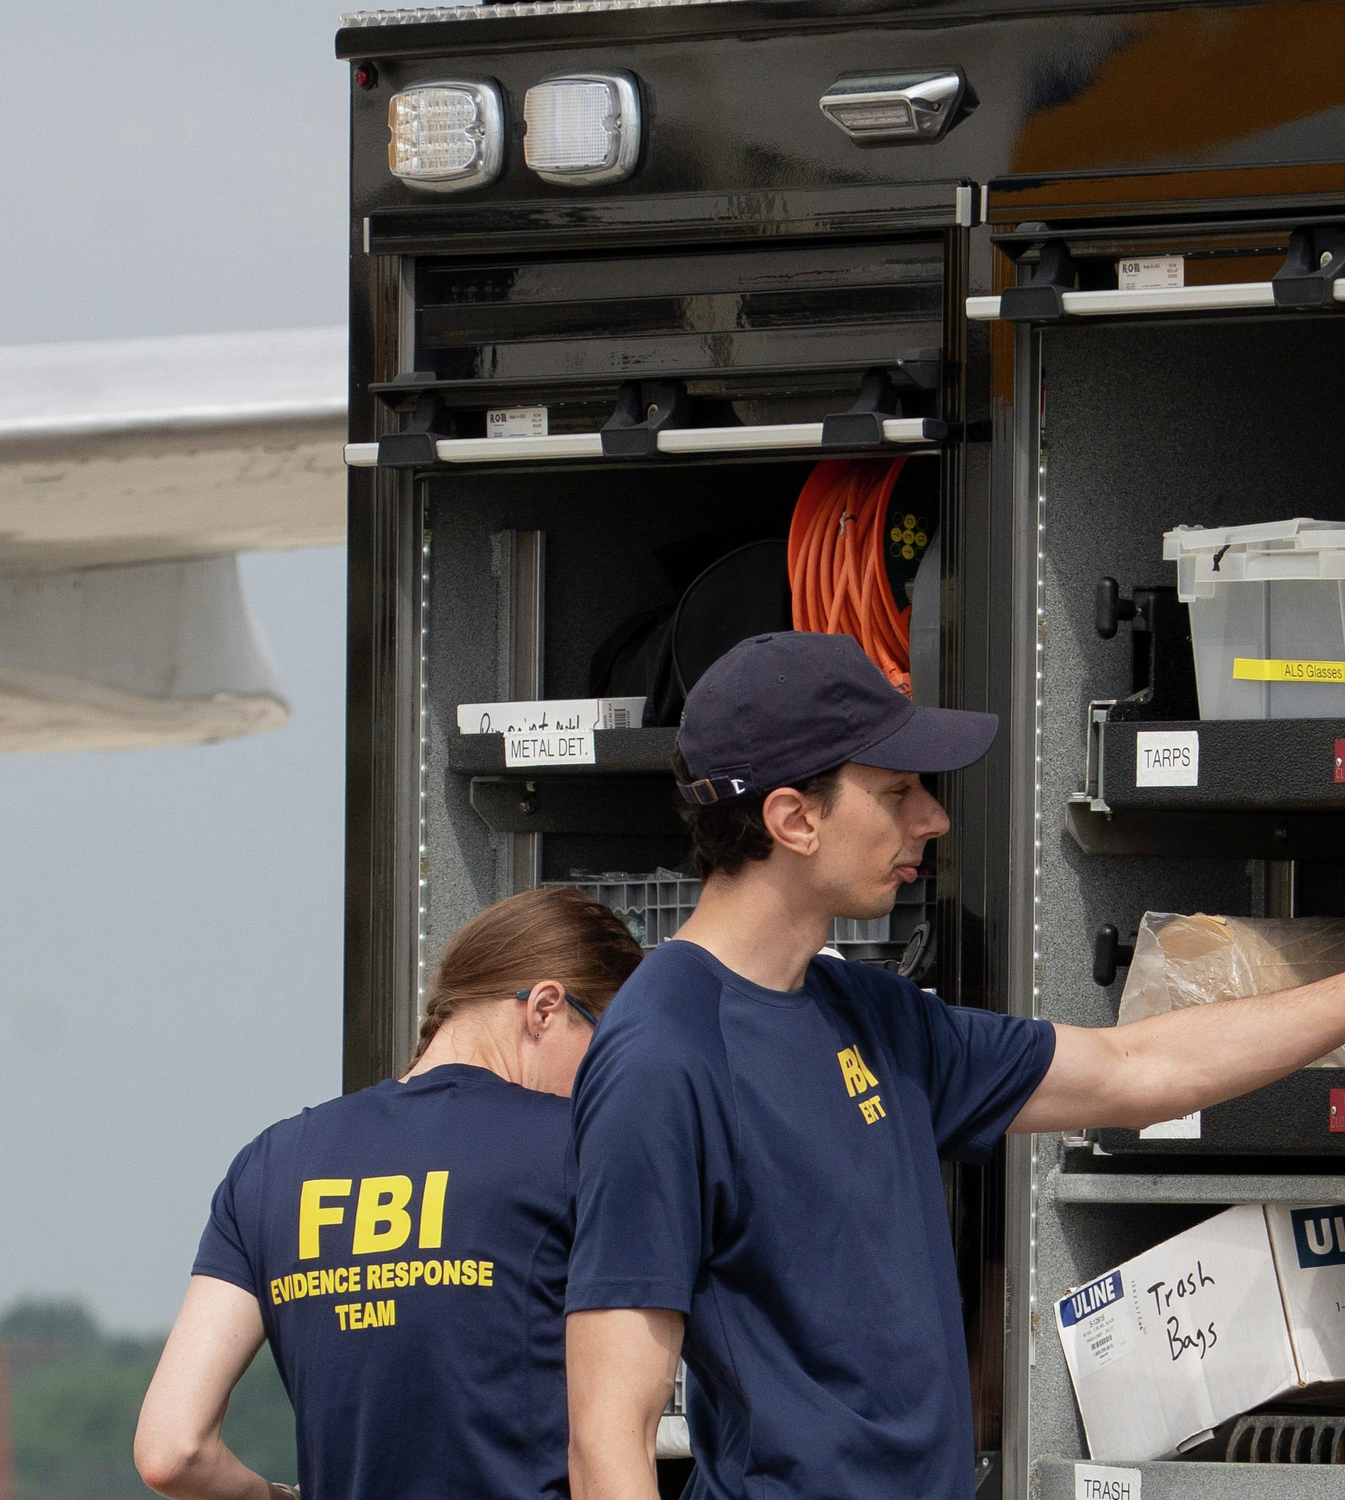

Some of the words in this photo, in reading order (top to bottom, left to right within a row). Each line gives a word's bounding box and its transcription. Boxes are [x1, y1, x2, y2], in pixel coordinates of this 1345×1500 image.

[1284, 664, 1304, 678] ALS
[1306, 664, 1343, 679] Glasses
[511, 739, 554, 758] METAL
[558, 738, 588, 757] DET.
[1144, 745, 1191, 769] TARPS
[858, 1094, 886, 1125] ERT
[297, 1170, 450, 1260] FBI
[271, 1265, 361, 1306] EVIDENCE
[366, 1259, 494, 1290] RESPONSE
[1072, 1276, 1116, 1319] ULINE
[1147, 1260, 1215, 1315] Trash
[334, 1300, 396, 1332] TEAM
[1166, 1315, 1218, 1361] Bags
[1084, 1479, 1130, 1500] TRASH
